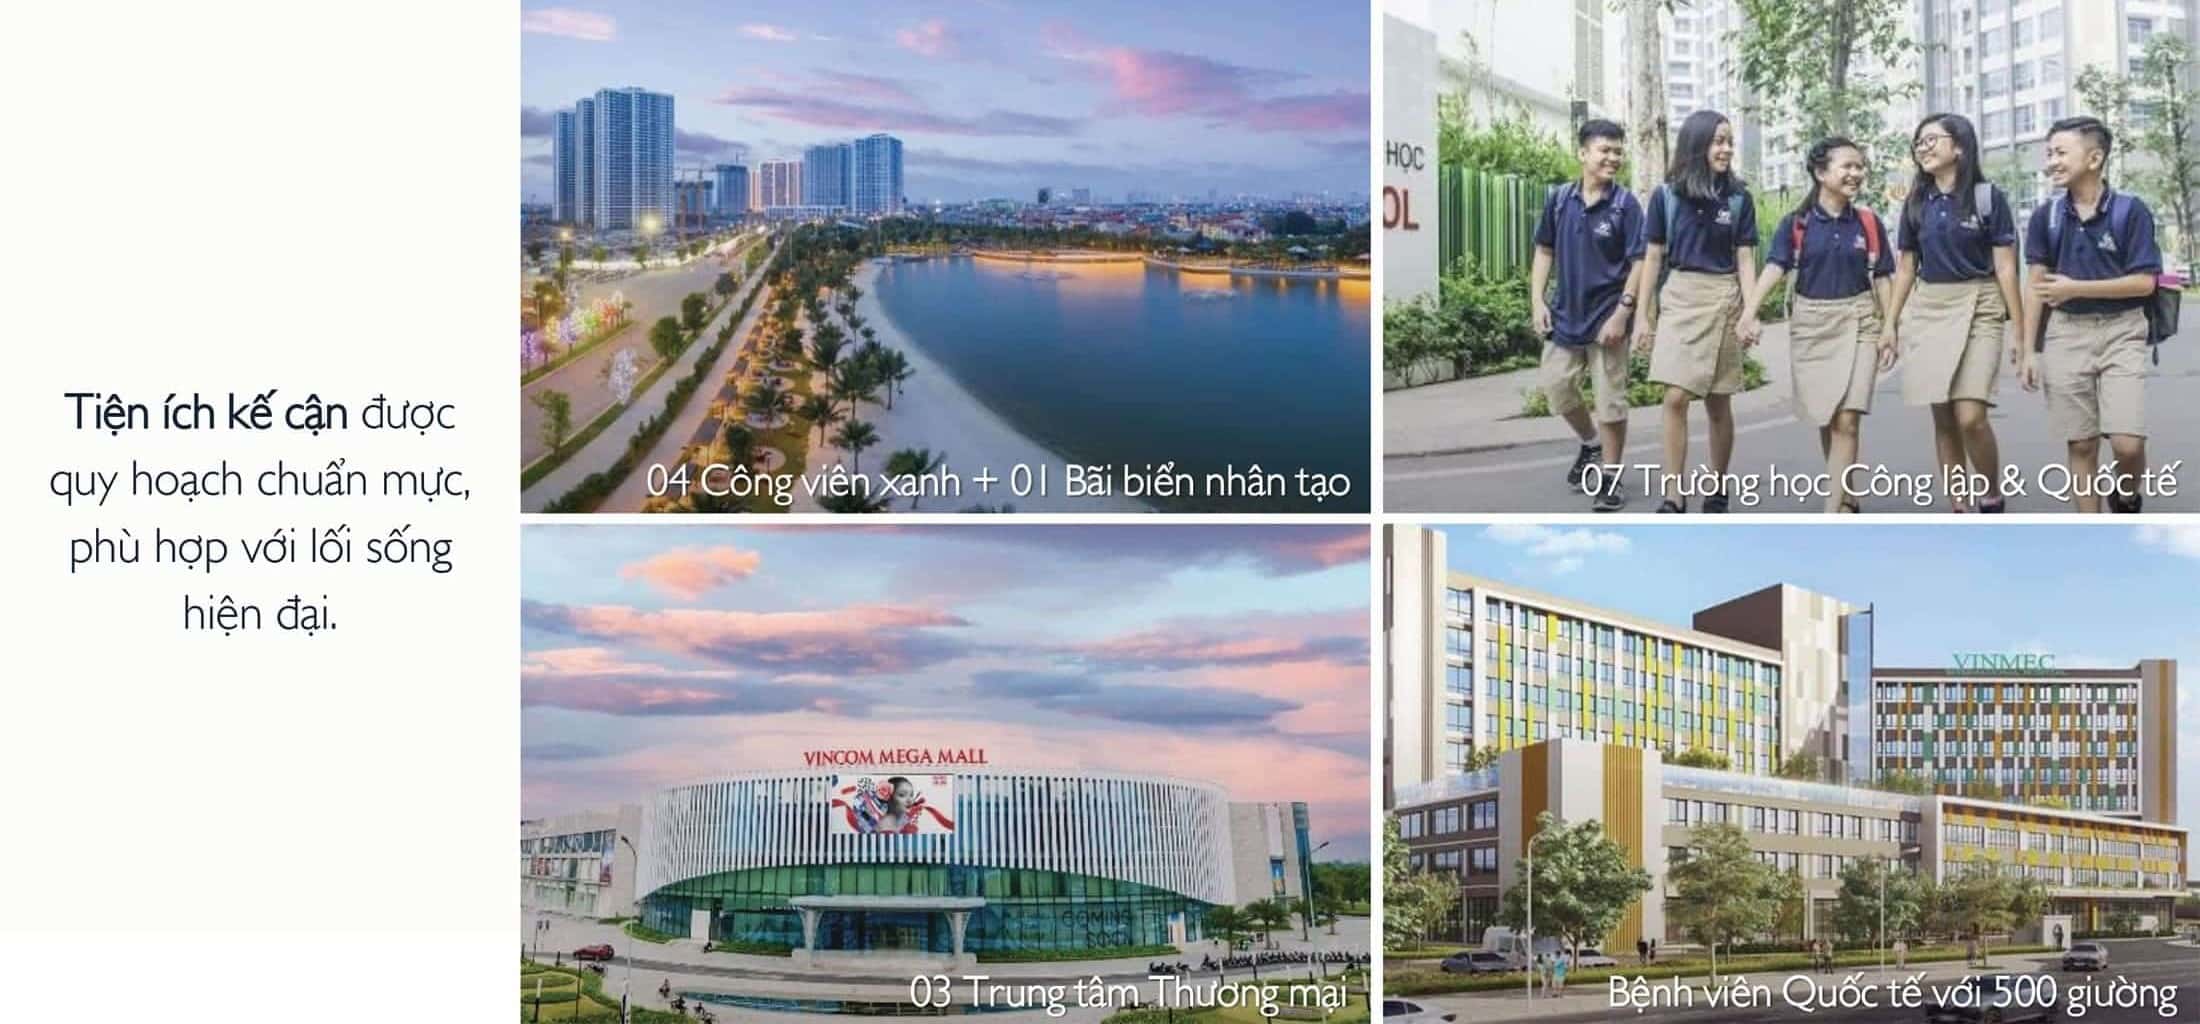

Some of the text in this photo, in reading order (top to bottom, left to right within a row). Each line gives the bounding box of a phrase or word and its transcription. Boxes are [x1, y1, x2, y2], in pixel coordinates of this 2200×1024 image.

[1386, 140, 1424, 173] HỌC
[1952, 653, 2056, 671] VINMEC
[804, 748, 988, 766] VINCOM MEGA MALL
